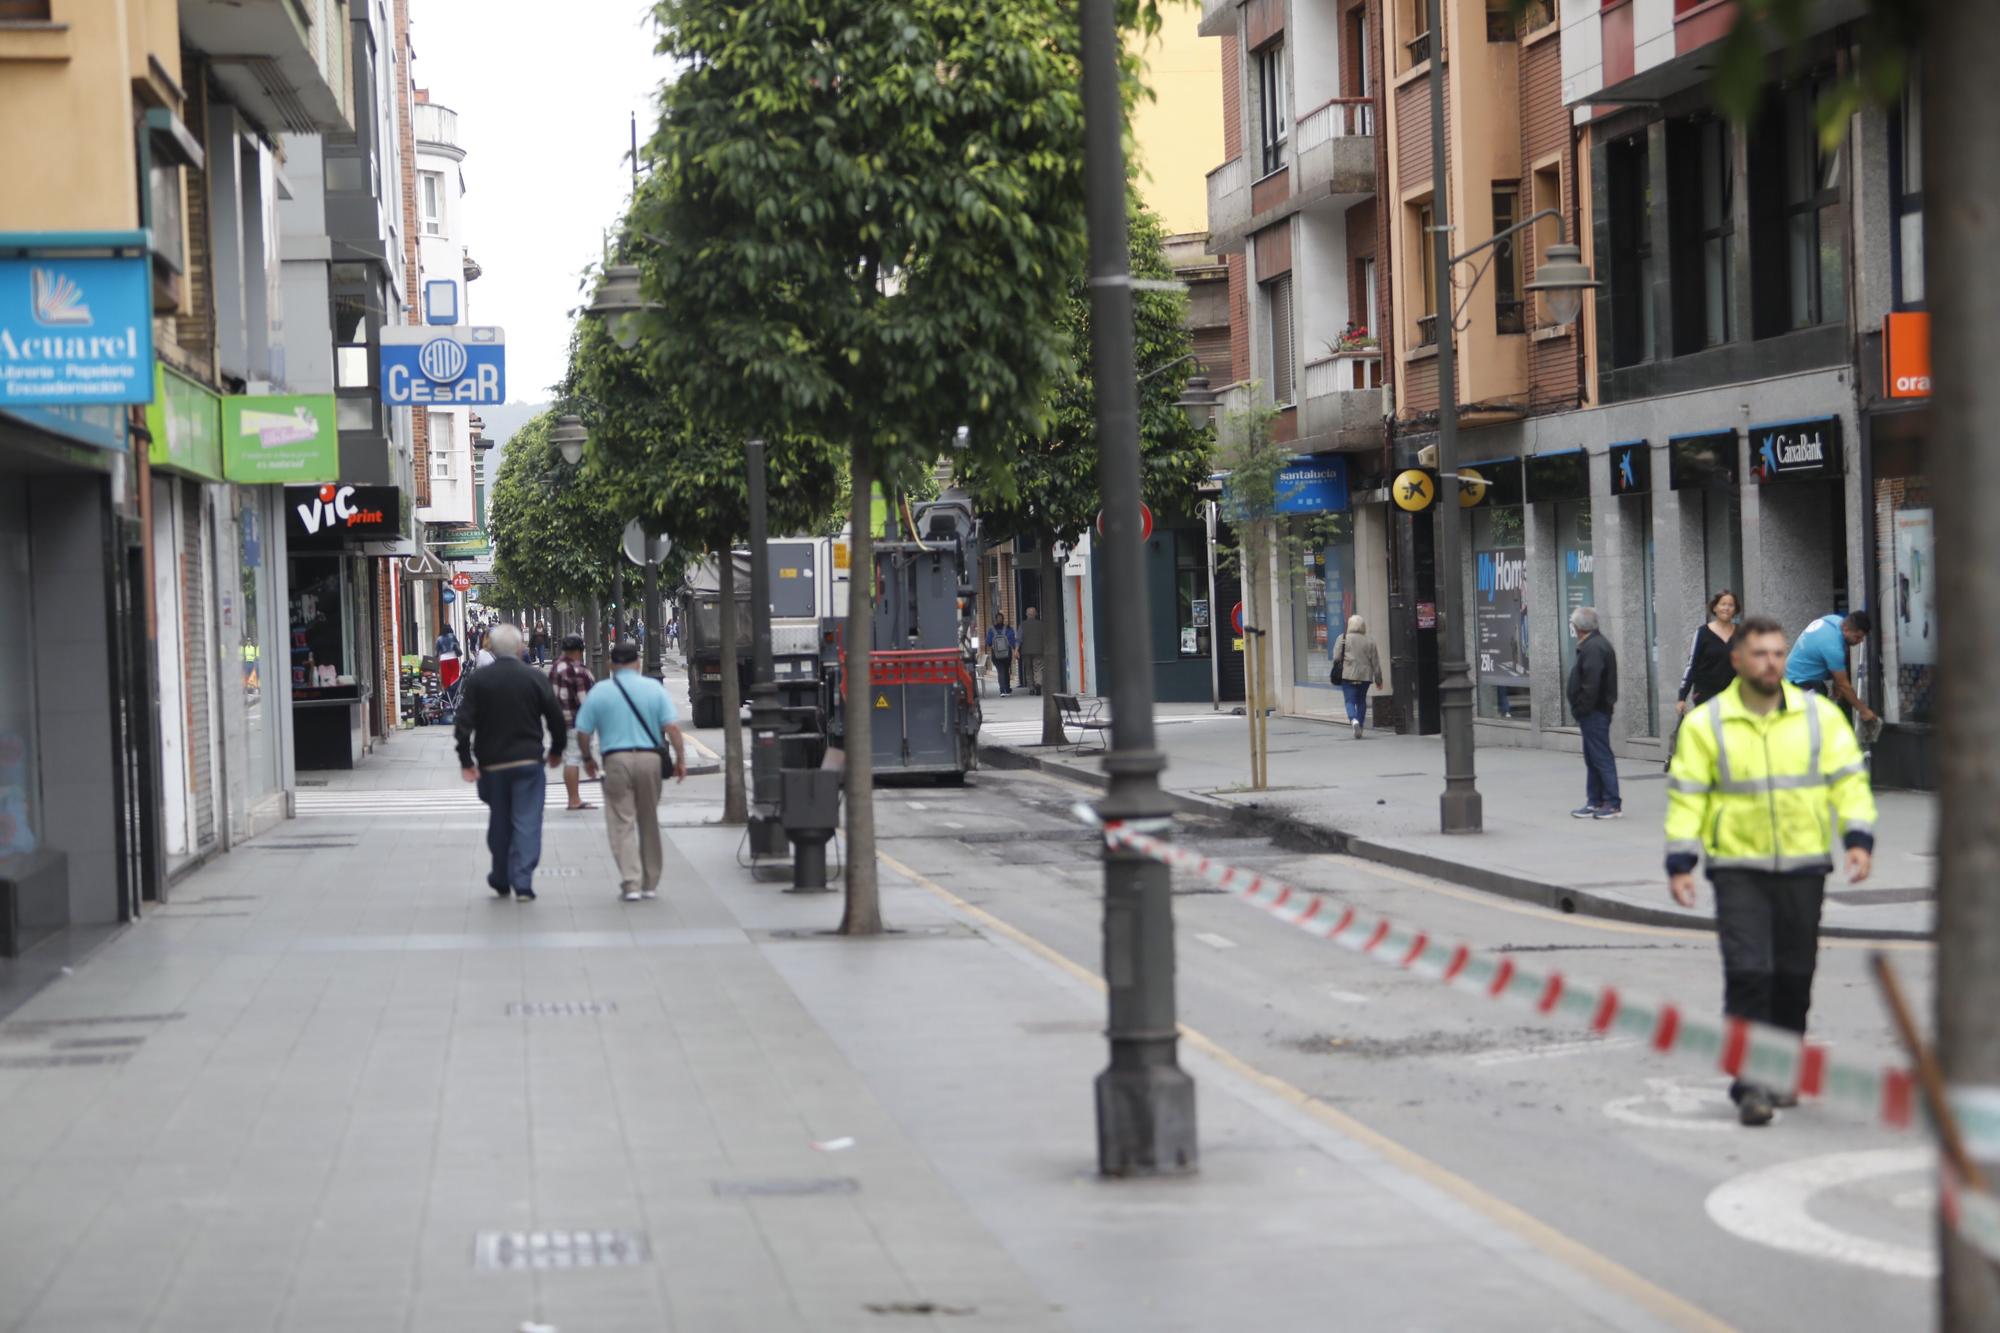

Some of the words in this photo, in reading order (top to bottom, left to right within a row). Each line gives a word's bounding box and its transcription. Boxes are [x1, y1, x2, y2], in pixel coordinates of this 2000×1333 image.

[424, 339, 462, 378] FOTO
[388, 363, 499, 402] CESAR
[1776, 431, 1824, 464] CaixaBank
[347, 508, 383, 528] print
[454, 575, 470, 585] ria
